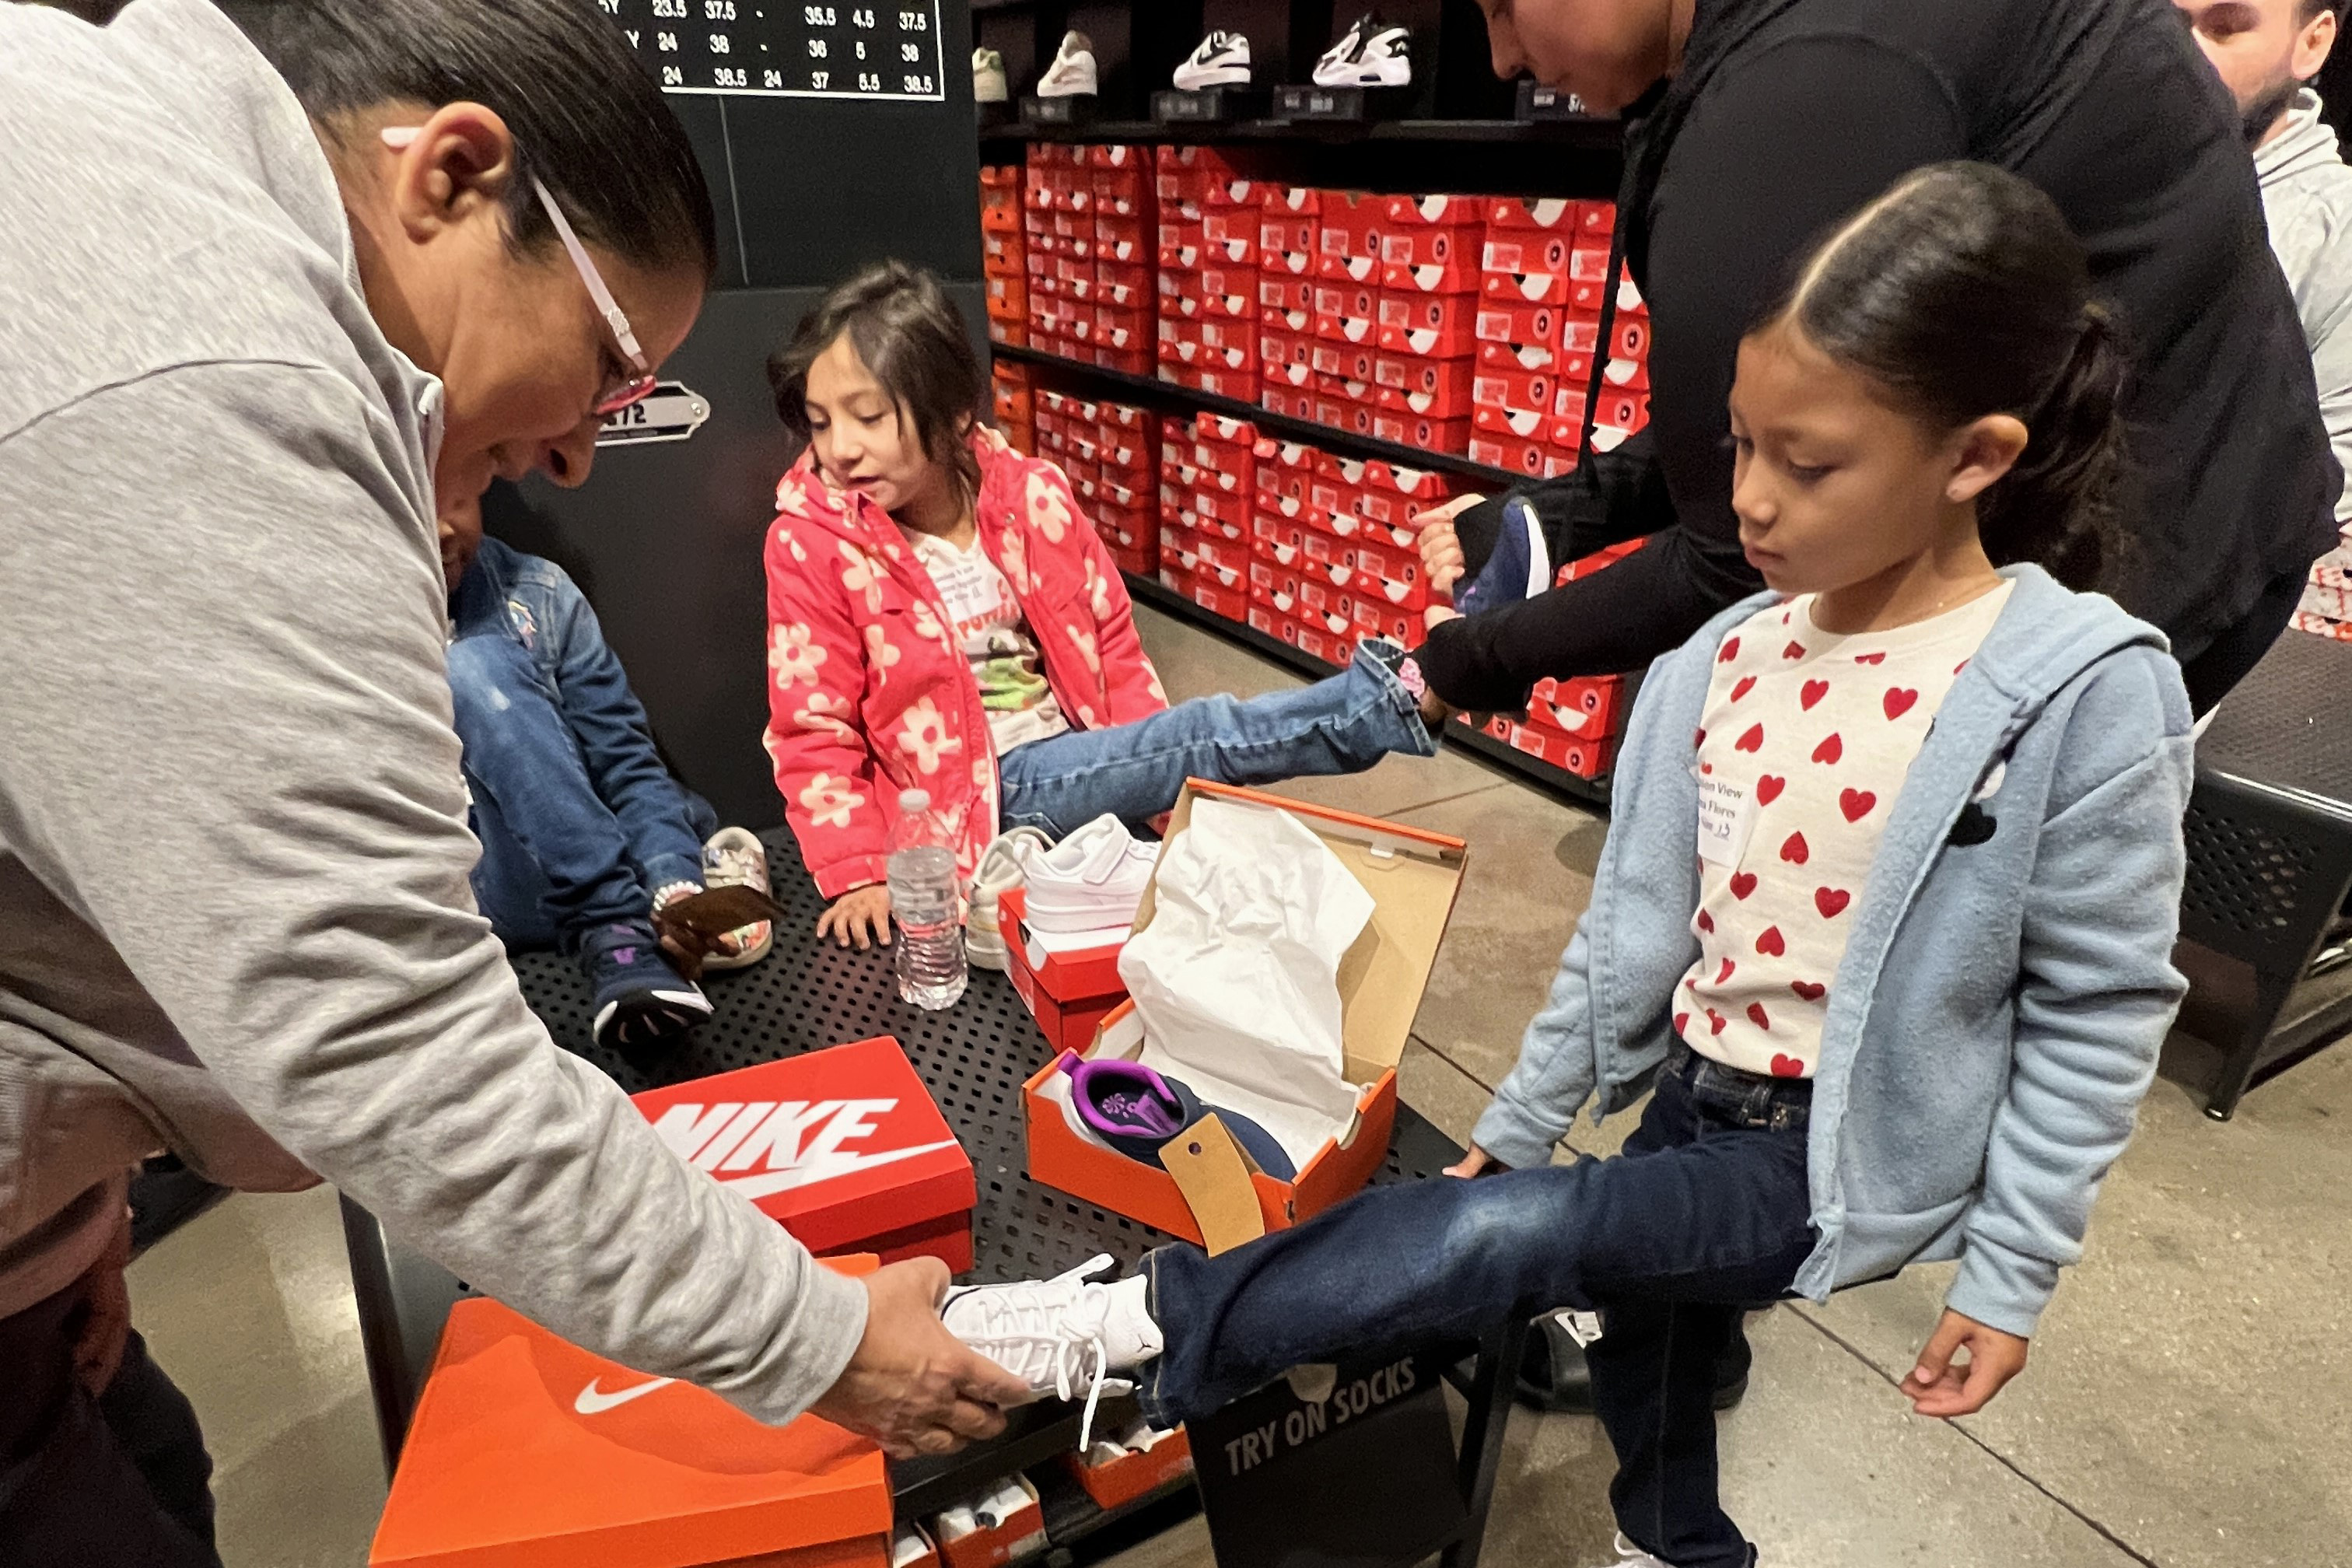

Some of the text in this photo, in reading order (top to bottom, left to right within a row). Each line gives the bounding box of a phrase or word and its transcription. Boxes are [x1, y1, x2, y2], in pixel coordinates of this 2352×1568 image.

[652, 0, 688, 18] 23.5
[705, 1, 737, 20] 37.5
[852, 9, 875, 28] 4.5
[899, 12, 927, 32] 37.5
[657, 32, 678, 51] 24
[709, 34, 730, 54] 38
[901, 44, 919, 62] 38
[663, 65, 933, 93] 24 38.5 24 37 5.5 38.5
[1718, 782, 1742, 799] View
[653, 1097, 899, 1171] NIKE
[1223, 1356, 1416, 1475] TRY ON SOCKS
